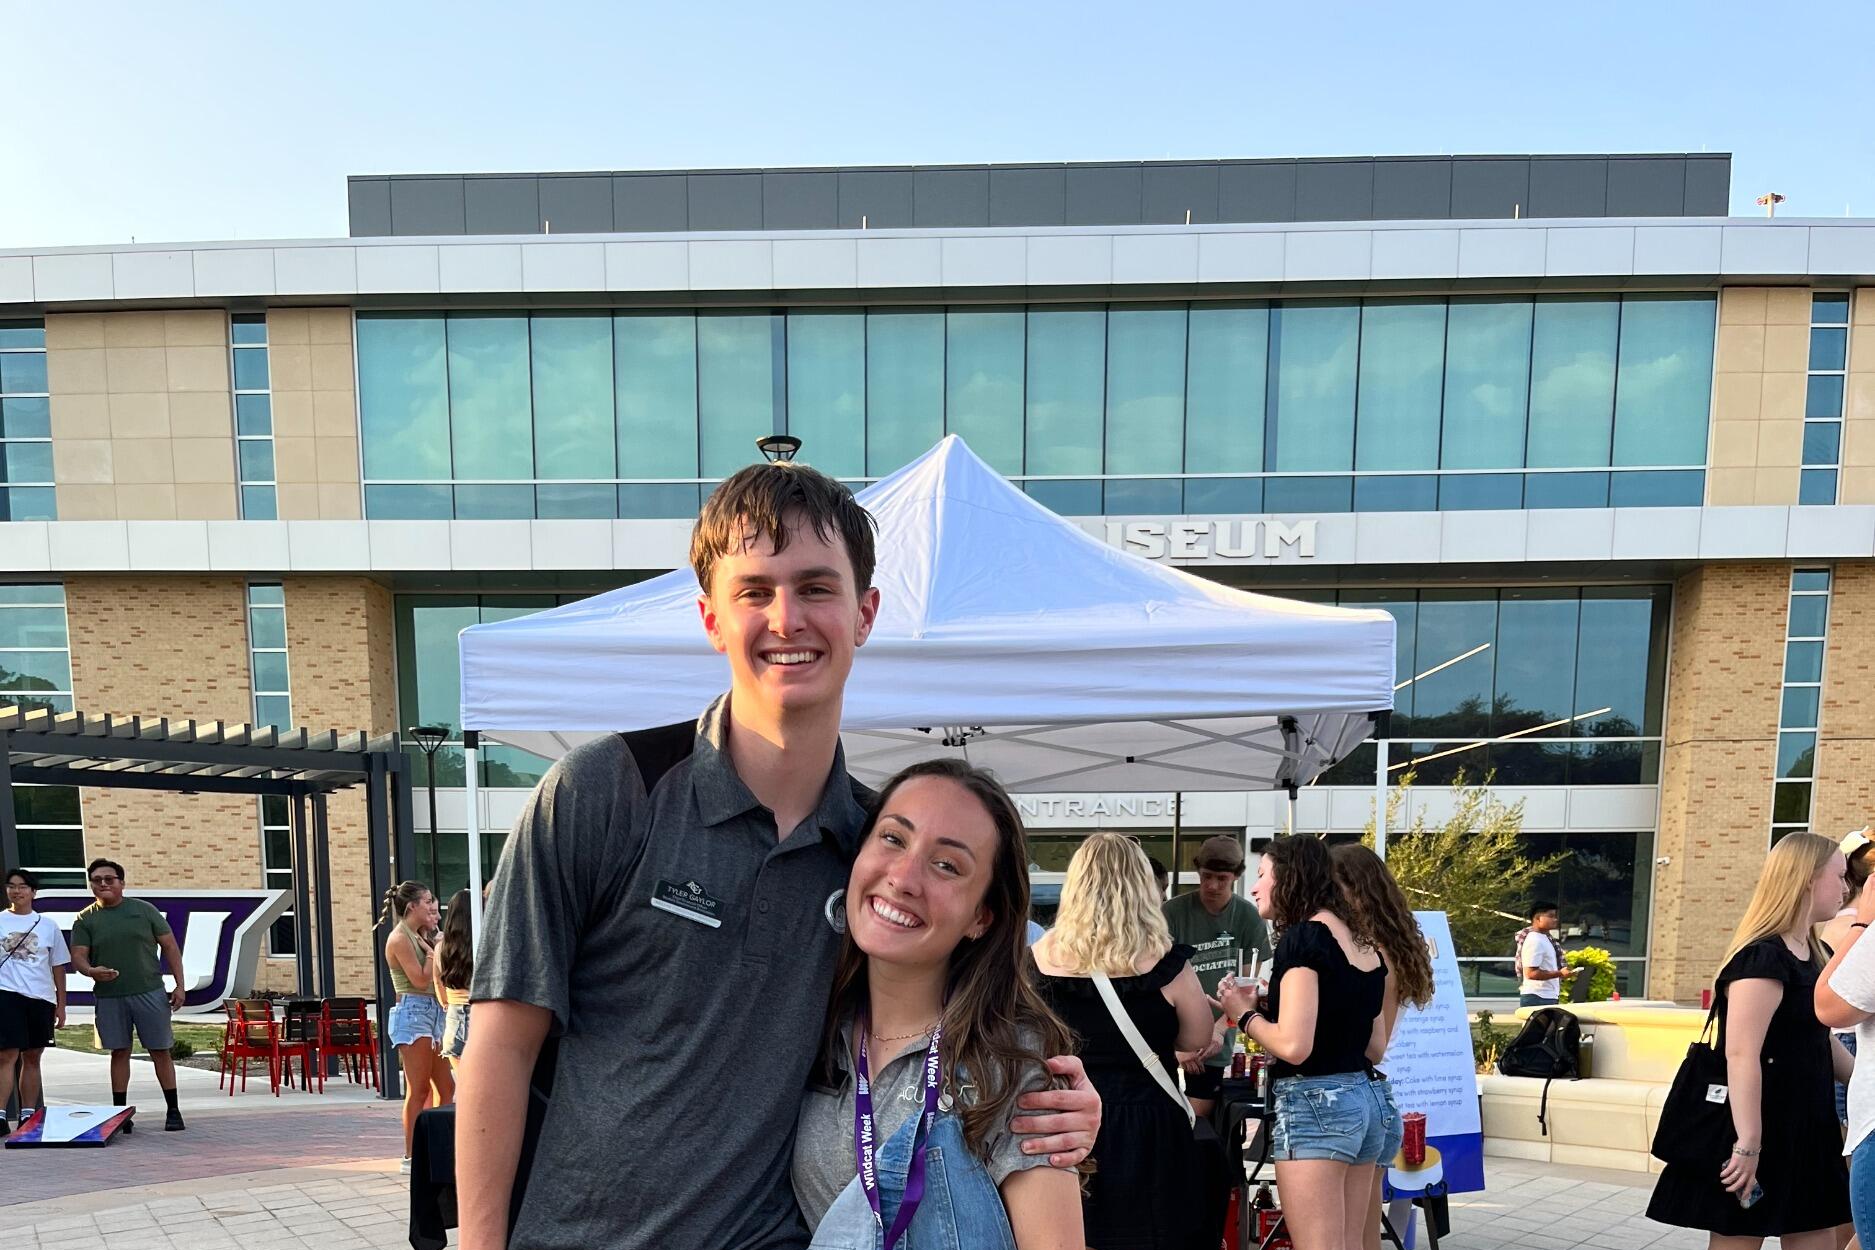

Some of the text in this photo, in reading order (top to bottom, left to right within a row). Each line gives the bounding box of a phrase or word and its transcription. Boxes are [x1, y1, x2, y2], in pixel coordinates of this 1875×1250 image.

[1104, 520, 1318, 558] ISEUM
[1017, 799, 1185, 817] NTRANCE
[1191, 939, 1230, 951] UDENT
[927, 1056, 939, 1088] Week
[1405, 1076, 1420, 1084] Coke
[1421, 1075, 1433, 1083] with
[897, 1086, 926, 1103] ACU
[861, 1113, 875, 1191] Wildcat Week
